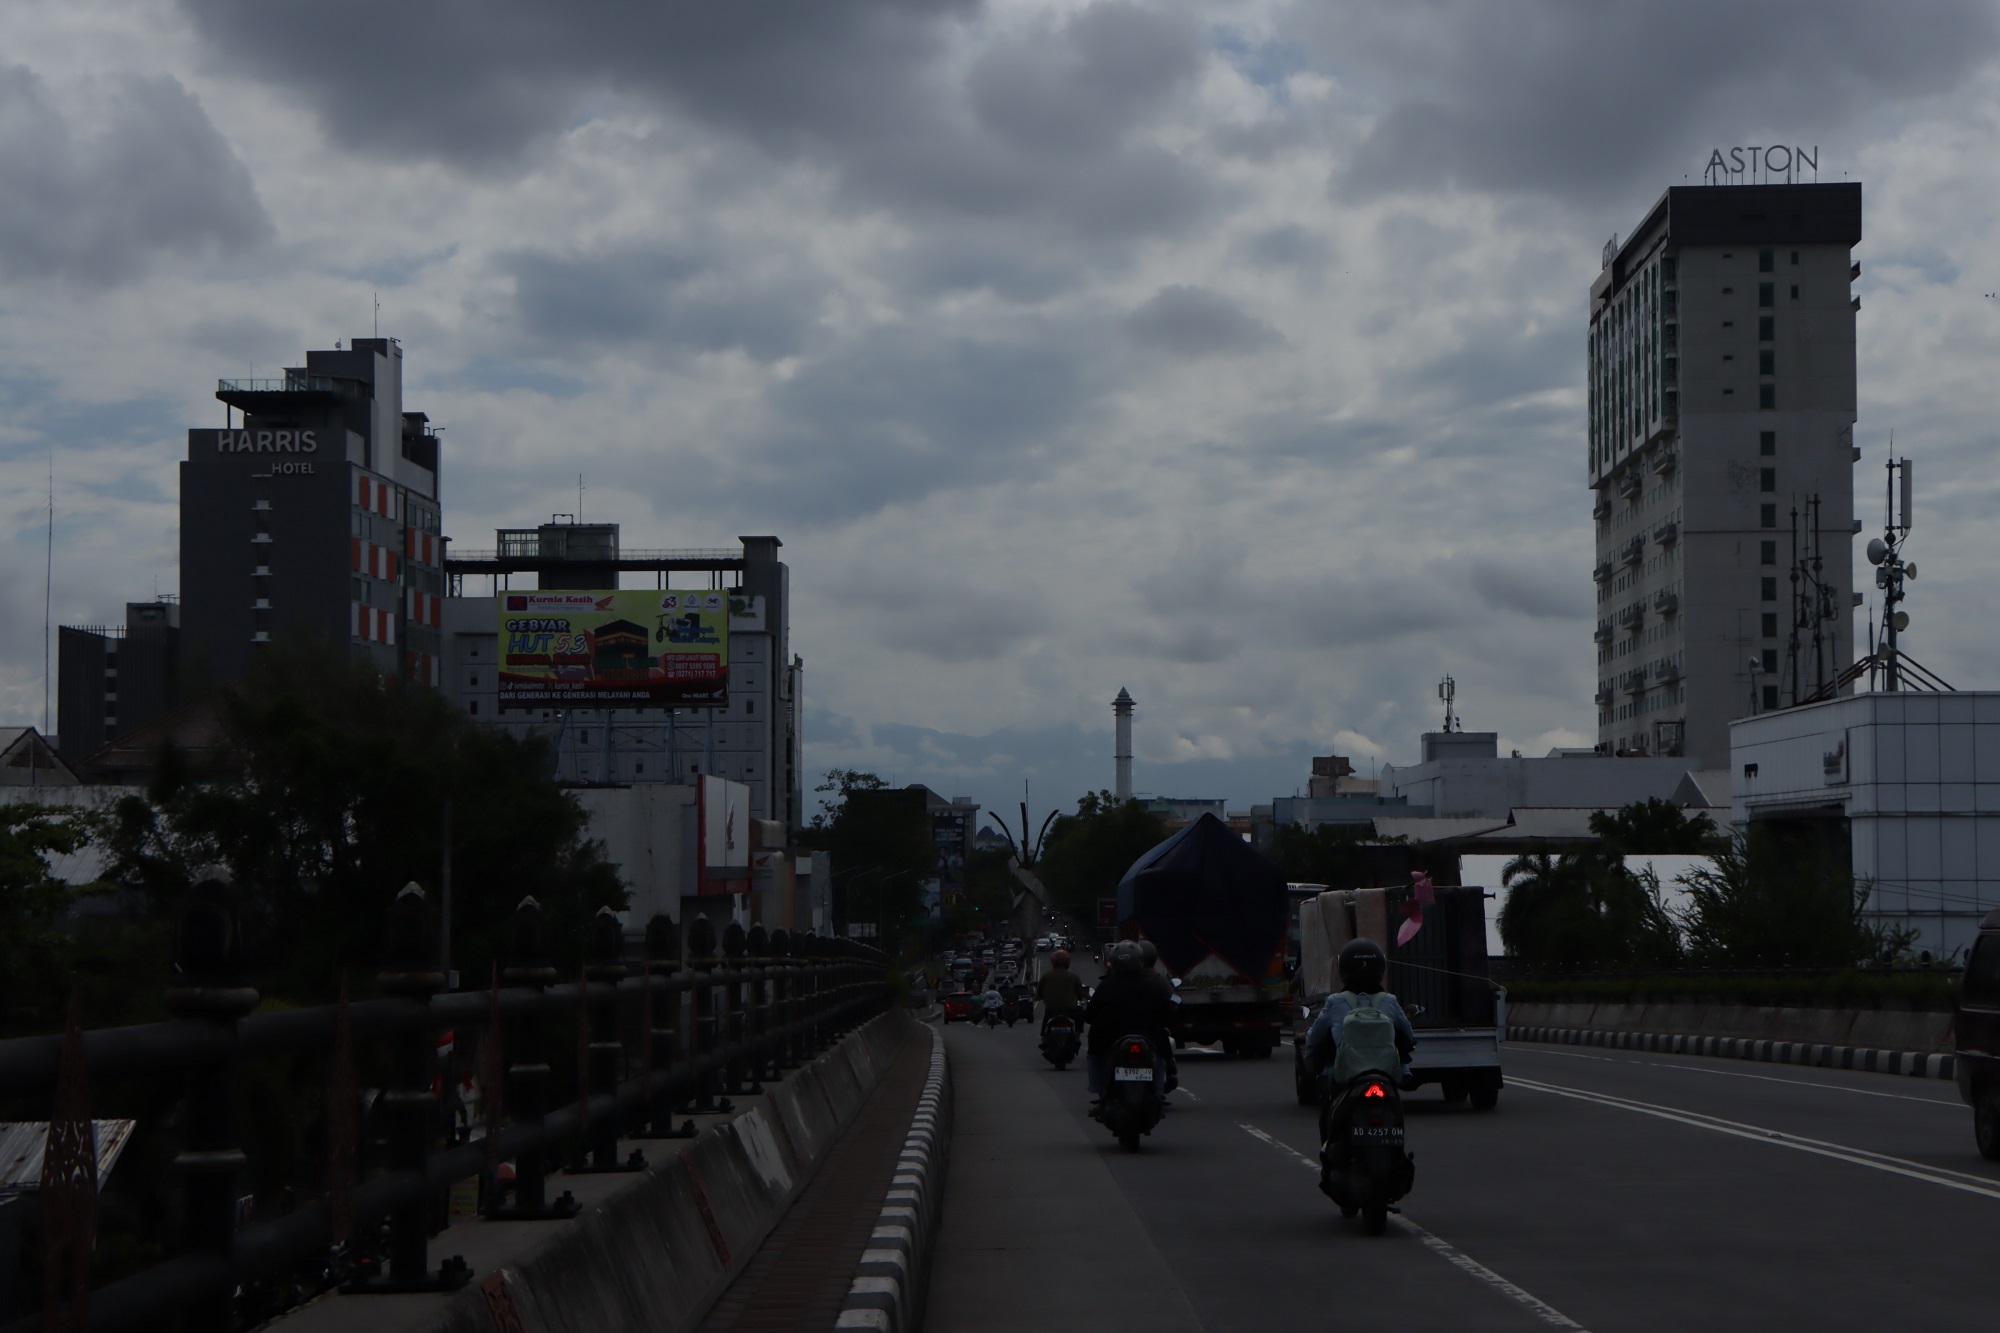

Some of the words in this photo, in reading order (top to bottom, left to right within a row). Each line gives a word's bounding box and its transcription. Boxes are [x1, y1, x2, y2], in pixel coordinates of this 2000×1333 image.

[1705, 145, 1818, 174] ASTON
[217, 430, 317, 453] HARRIS
[271, 462, 315, 474] HOTEL
[528, 595, 563, 603] Kurnia
[566, 595, 593, 603] Kasih
[505, 618, 571, 633] GEBYAR
[508, 634, 554, 653] HUT
[554, 634, 587, 653] 53
[675, 670, 694, 679] (0271)
[694, 670, 705, 678] 717
[706, 670, 716, 678] 717
[500, 692, 516, 700] DARI
[517, 692, 551, 700] GENERASI
[552, 692, 562, 700] KE
[563, 692, 596, 700] GENERASI
[632, 691, 650, 699] ANDA
[1354, 1127, 1364, 1136] AD
[1368, 1128, 1388, 1136] 4257
